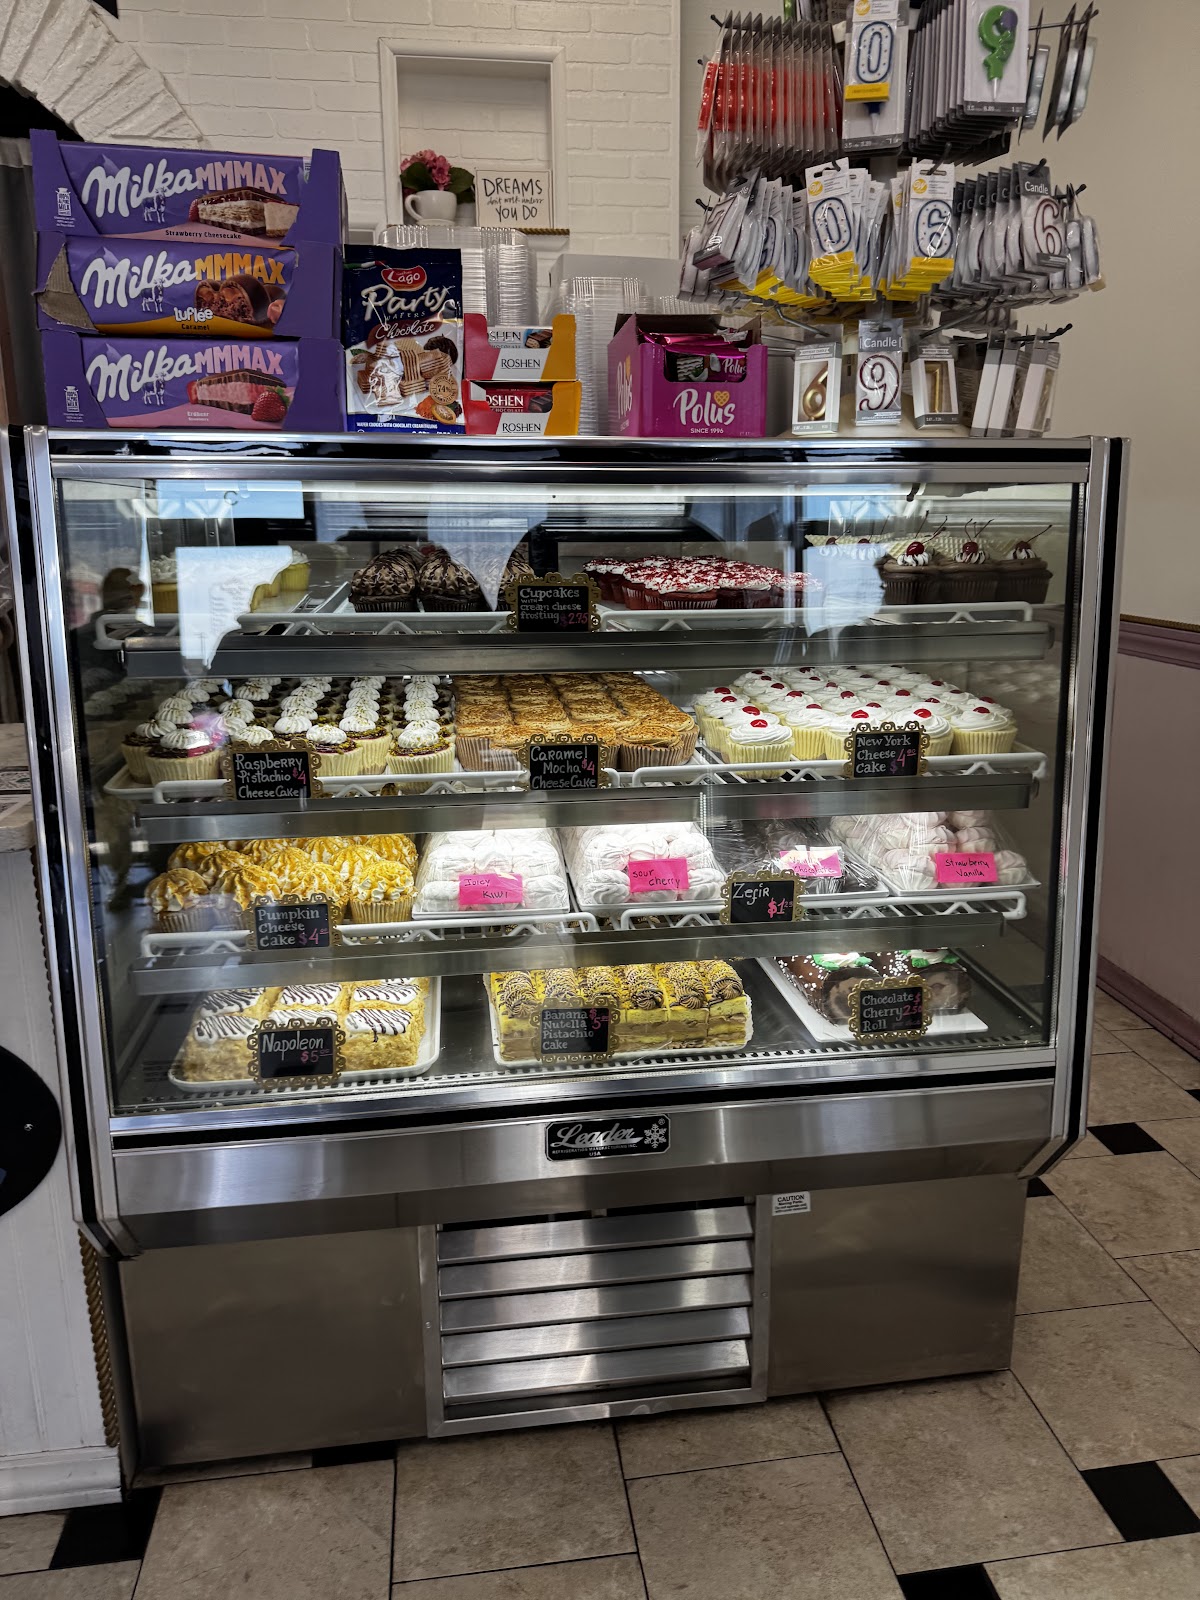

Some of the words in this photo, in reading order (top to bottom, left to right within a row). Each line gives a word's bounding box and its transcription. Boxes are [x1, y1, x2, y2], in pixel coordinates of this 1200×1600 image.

[82, 158, 199, 217] Milka
[196, 160, 288, 195] MMMAX
[481, 177, 543, 197] DREAMS
[1025, 181, 1048, 195] Candle
[495, 205, 518, 222] YOU
[522, 204, 538, 220] DO
[165, 229, 203, 238] Strawberry
[204, 231, 242, 239] Cheesecake
[81, 250, 198, 308] Milka
[195, 253, 286, 285] MMMAX
[387, 270, 420, 284] Lago
[361, 284, 449, 321] Party
[386, 310, 426, 321] WAFERS
[181, 323, 210, 331] Caramel
[375, 320, 436, 339] Chocolate
[487, 331, 521, 341] SHEN
[863, 336, 898, 348] Candle
[501, 358, 541, 369] ROSHEN
[722, 357, 747, 374] Polus
[86, 345, 197, 402] Milka
[195, 344, 284, 375] MMMAX
[486, 394, 524, 406] OSHEN
[672, 388, 736, 426] Polus
[502, 422, 541, 432] ROSHEN
[520, 587, 580, 601] Cupcakes
[520, 603, 550, 611] cream
[551, 602, 582, 611] cheese
[520, 610, 560, 624] frosting
[856, 736, 883, 748] New
[883, 734, 911, 747] York
[856, 749, 896, 760] Cheese
[543, 760, 581, 774] Mocha
[856, 761, 887, 774] Cake
[237, 770, 292, 784] Pistachio
[945, 857, 990, 868] Strawberry
[632, 869, 654, 878] sour
[956, 868, 985, 878] Vanilla
[648, 876, 681, 889] cherry
[257, 907, 320, 923] Pumpkin
[258, 922, 305, 933] Cheese
[259, 934, 296, 947] Cake
[861, 992, 914, 1006] Chocolate
[544, 1010, 589, 1020] Banana
[862, 1007, 903, 1021] Cherry
[543, 1019, 587, 1030] Nutella
[862, 1018, 887, 1032] Roll
[543, 1028, 594, 1039] Pistachio
[261, 1030, 324, 1061] Napoleon
[542, 1040, 568, 1050] Cake
[550, 1122, 644, 1149] Leader
[552, 1147, 588, 1155] REFRIGERATION
[777, 1194, 804, 1203] CAUTION
